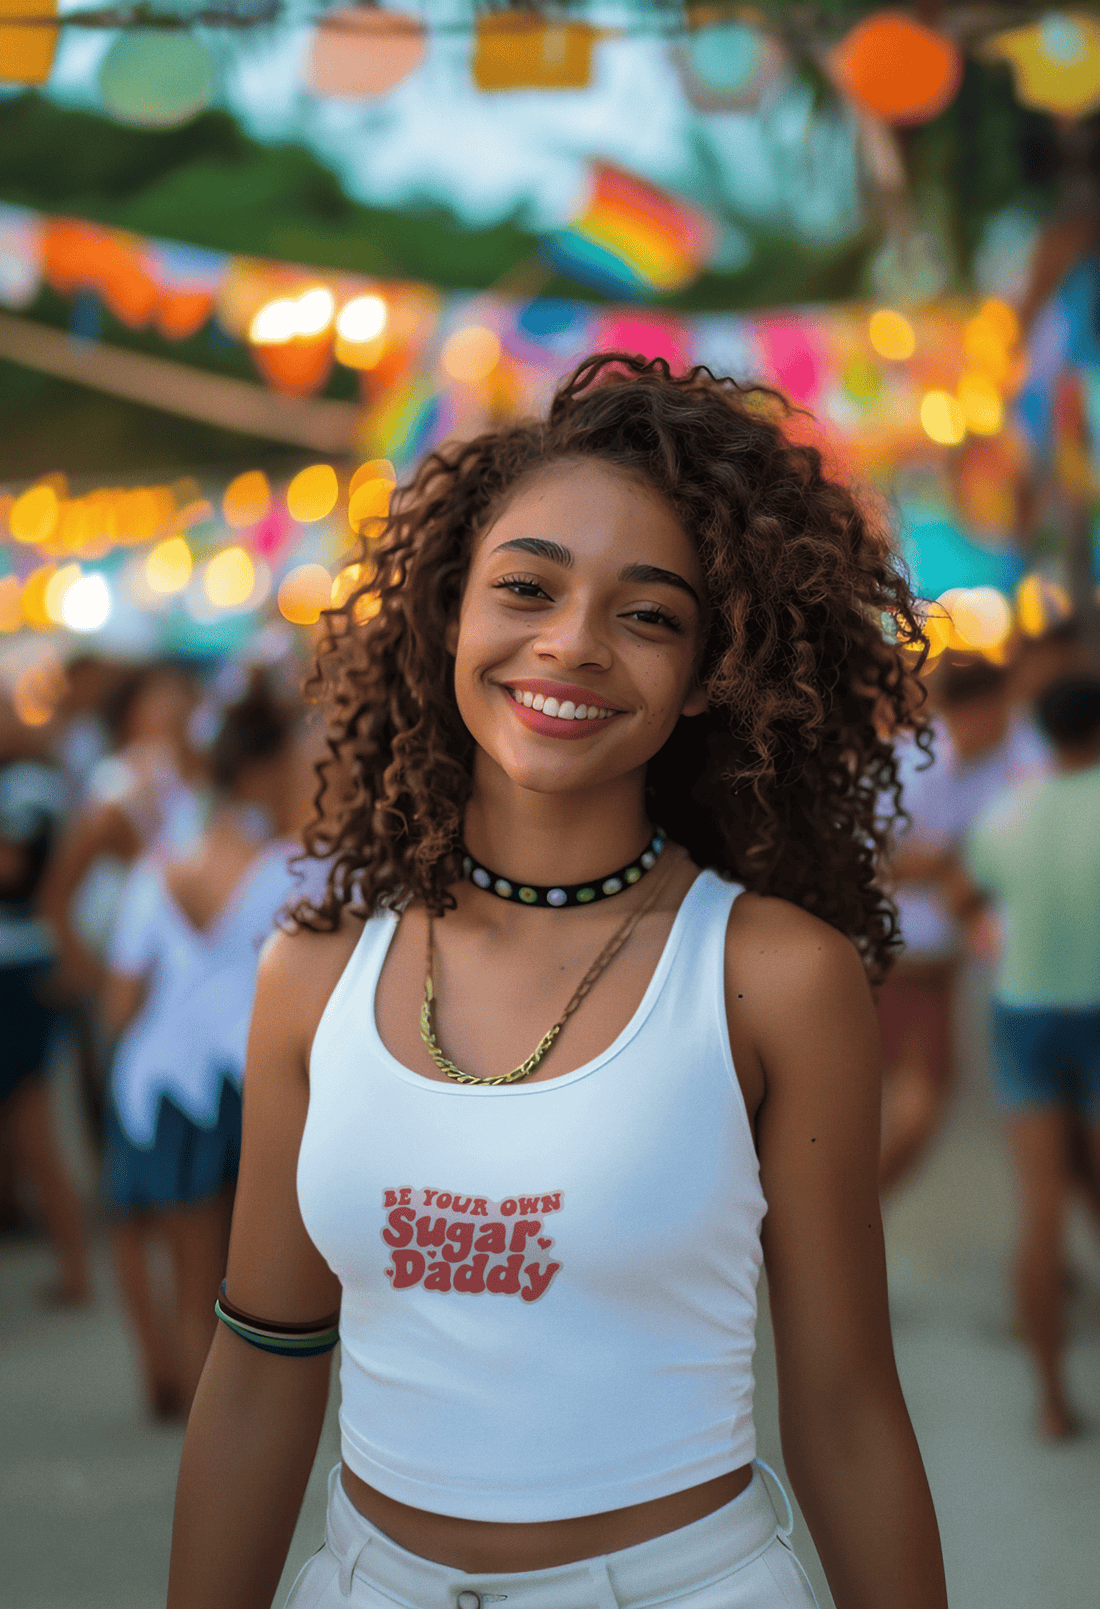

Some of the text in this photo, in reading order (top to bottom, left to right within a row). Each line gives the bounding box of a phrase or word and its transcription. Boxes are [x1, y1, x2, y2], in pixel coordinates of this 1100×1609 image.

[384, 1188, 561, 1217] BE YOUR OWN
[382, 1206, 541, 1263] Sugar
[391, 1249, 560, 1302] Daddy
